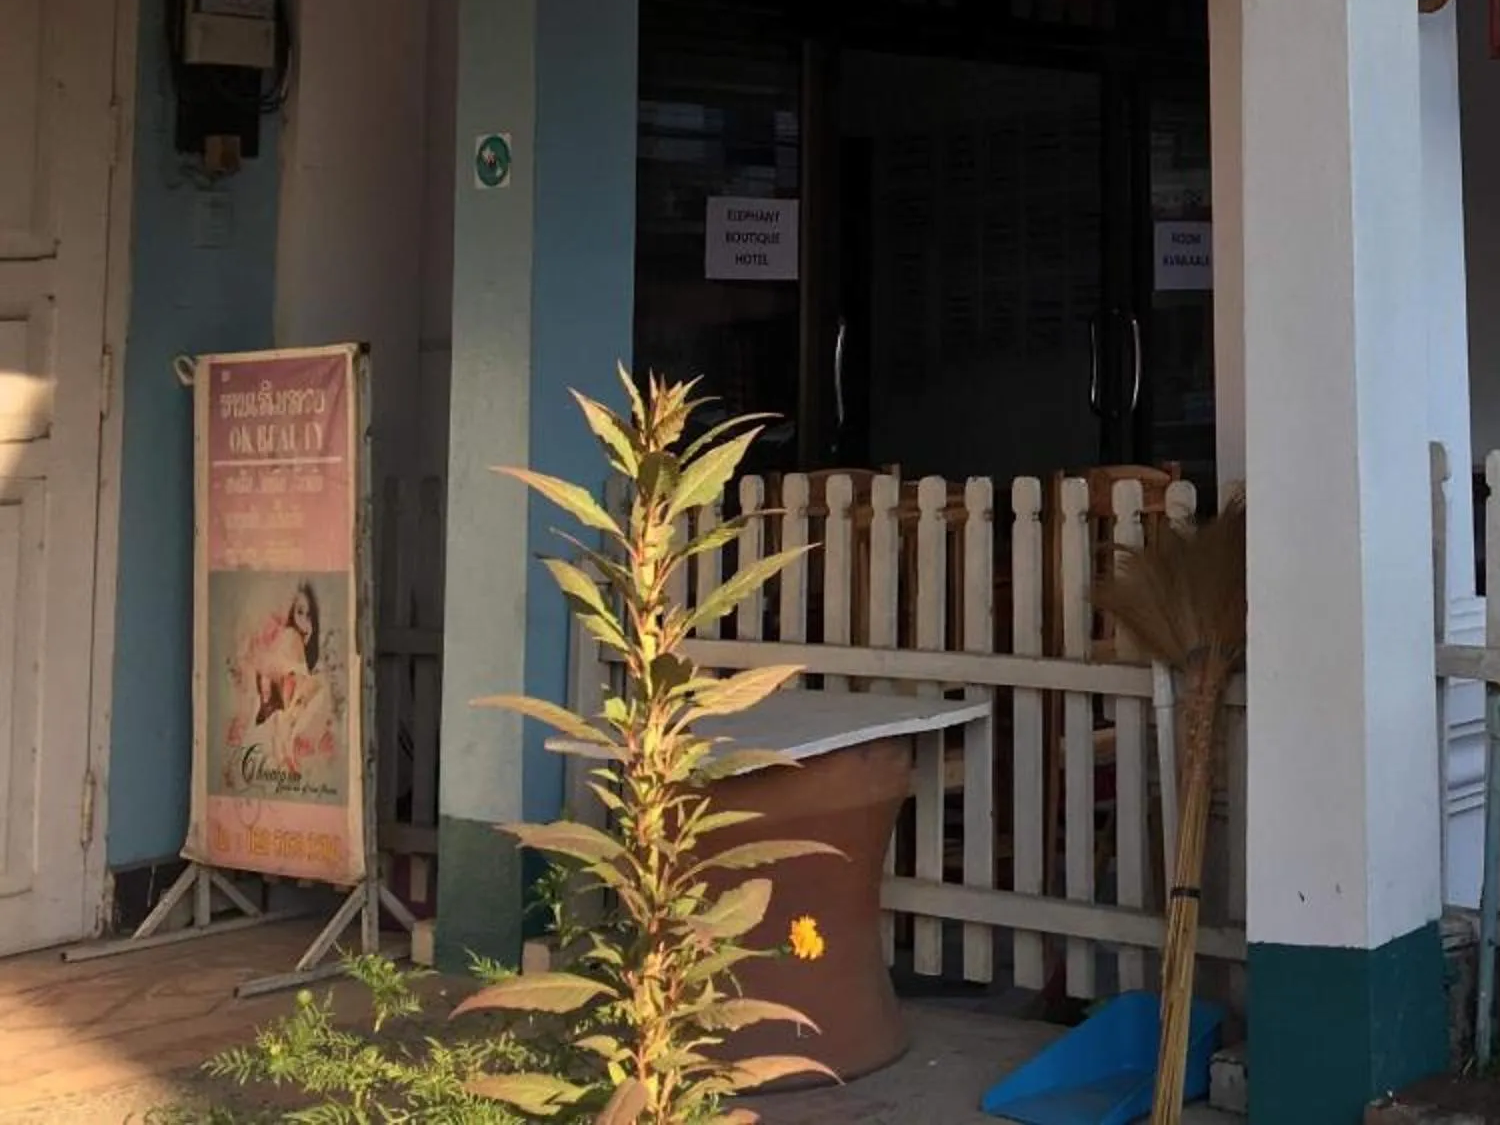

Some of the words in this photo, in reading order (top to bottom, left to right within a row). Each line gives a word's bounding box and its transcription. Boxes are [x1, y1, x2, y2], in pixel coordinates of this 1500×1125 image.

[727, 208, 781, 223] ELEPHANT
[725, 231, 781, 245] BOUTIQUE
[735, 253, 769, 266] HOTEL
